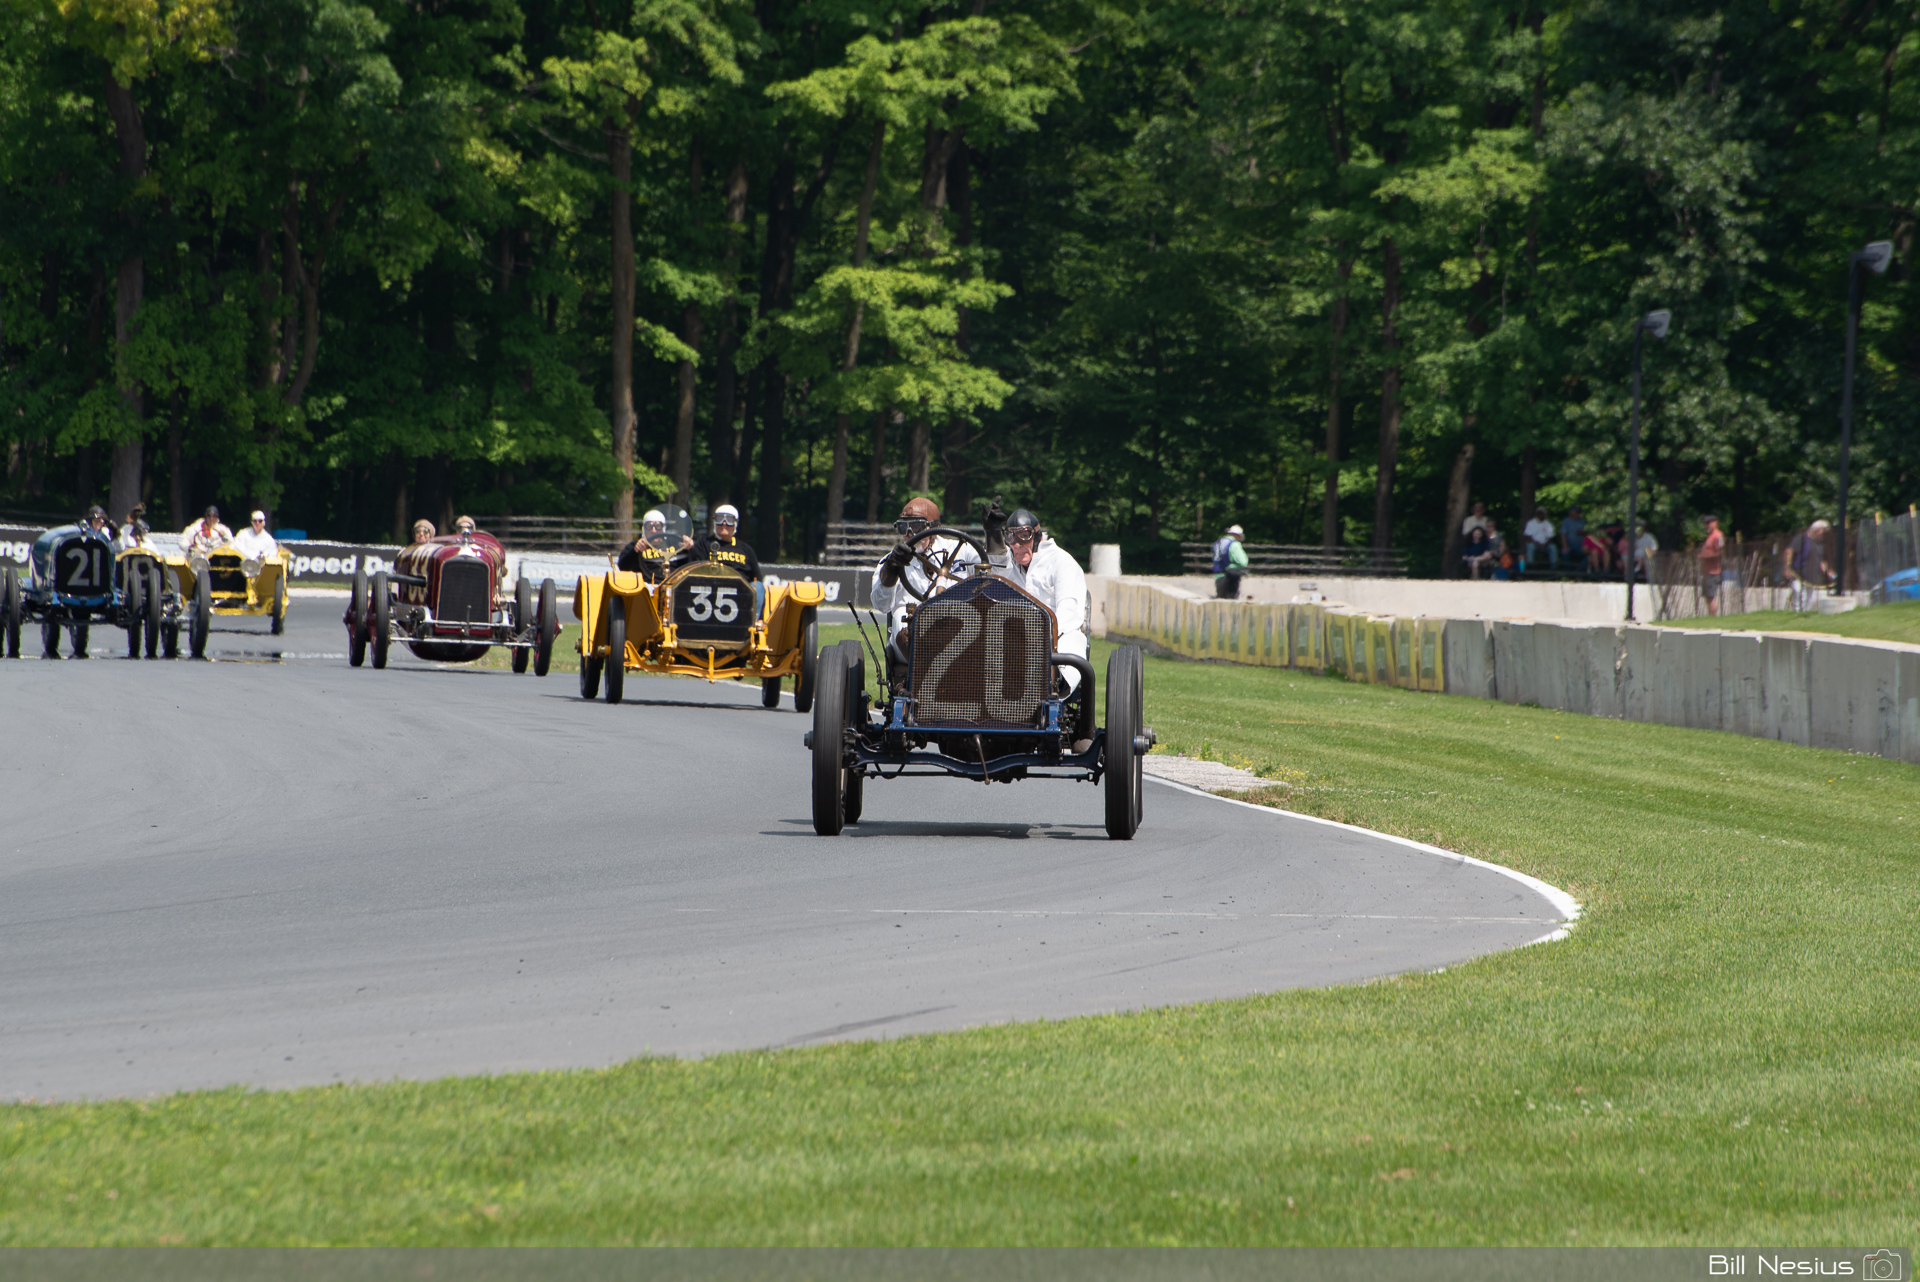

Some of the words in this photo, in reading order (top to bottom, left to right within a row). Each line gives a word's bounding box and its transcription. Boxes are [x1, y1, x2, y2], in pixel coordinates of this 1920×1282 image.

[66, 547, 101, 587] 21
[709, 551, 746, 565] ERCER
[687, 586, 739, 623] 35
[913, 599, 1045, 723] 20
